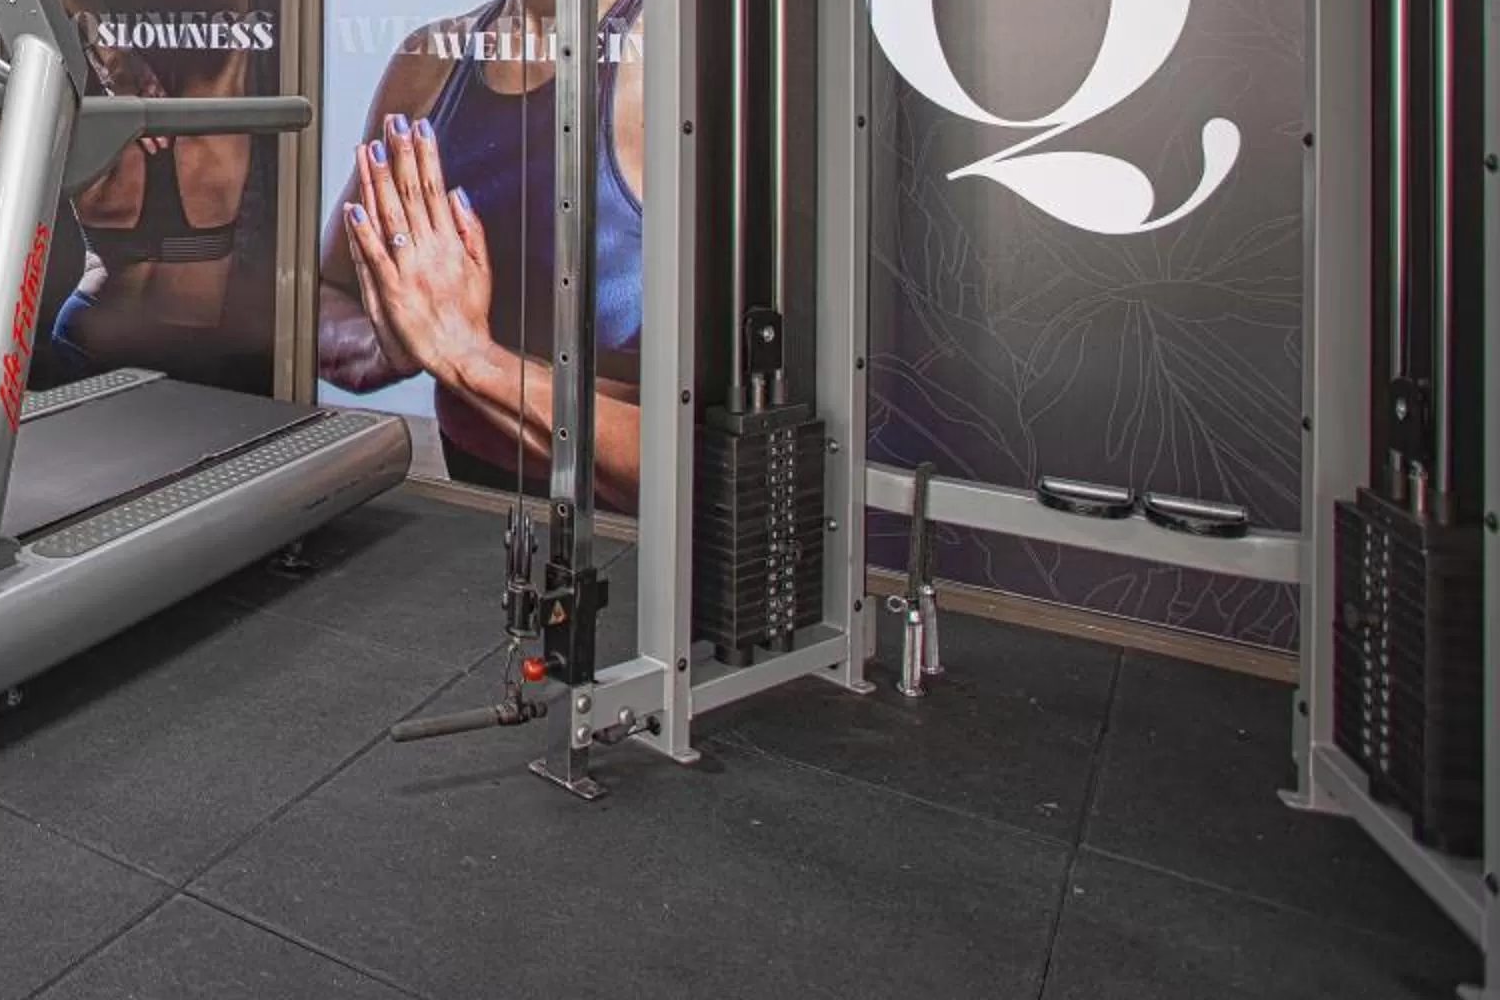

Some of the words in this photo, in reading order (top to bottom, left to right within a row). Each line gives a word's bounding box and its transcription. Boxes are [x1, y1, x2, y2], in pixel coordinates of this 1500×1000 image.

[96, 22, 274, 50] SLOWNESS
[431, 32, 644, 62] WELLIN
[12, 221, 50, 357] Fitness
